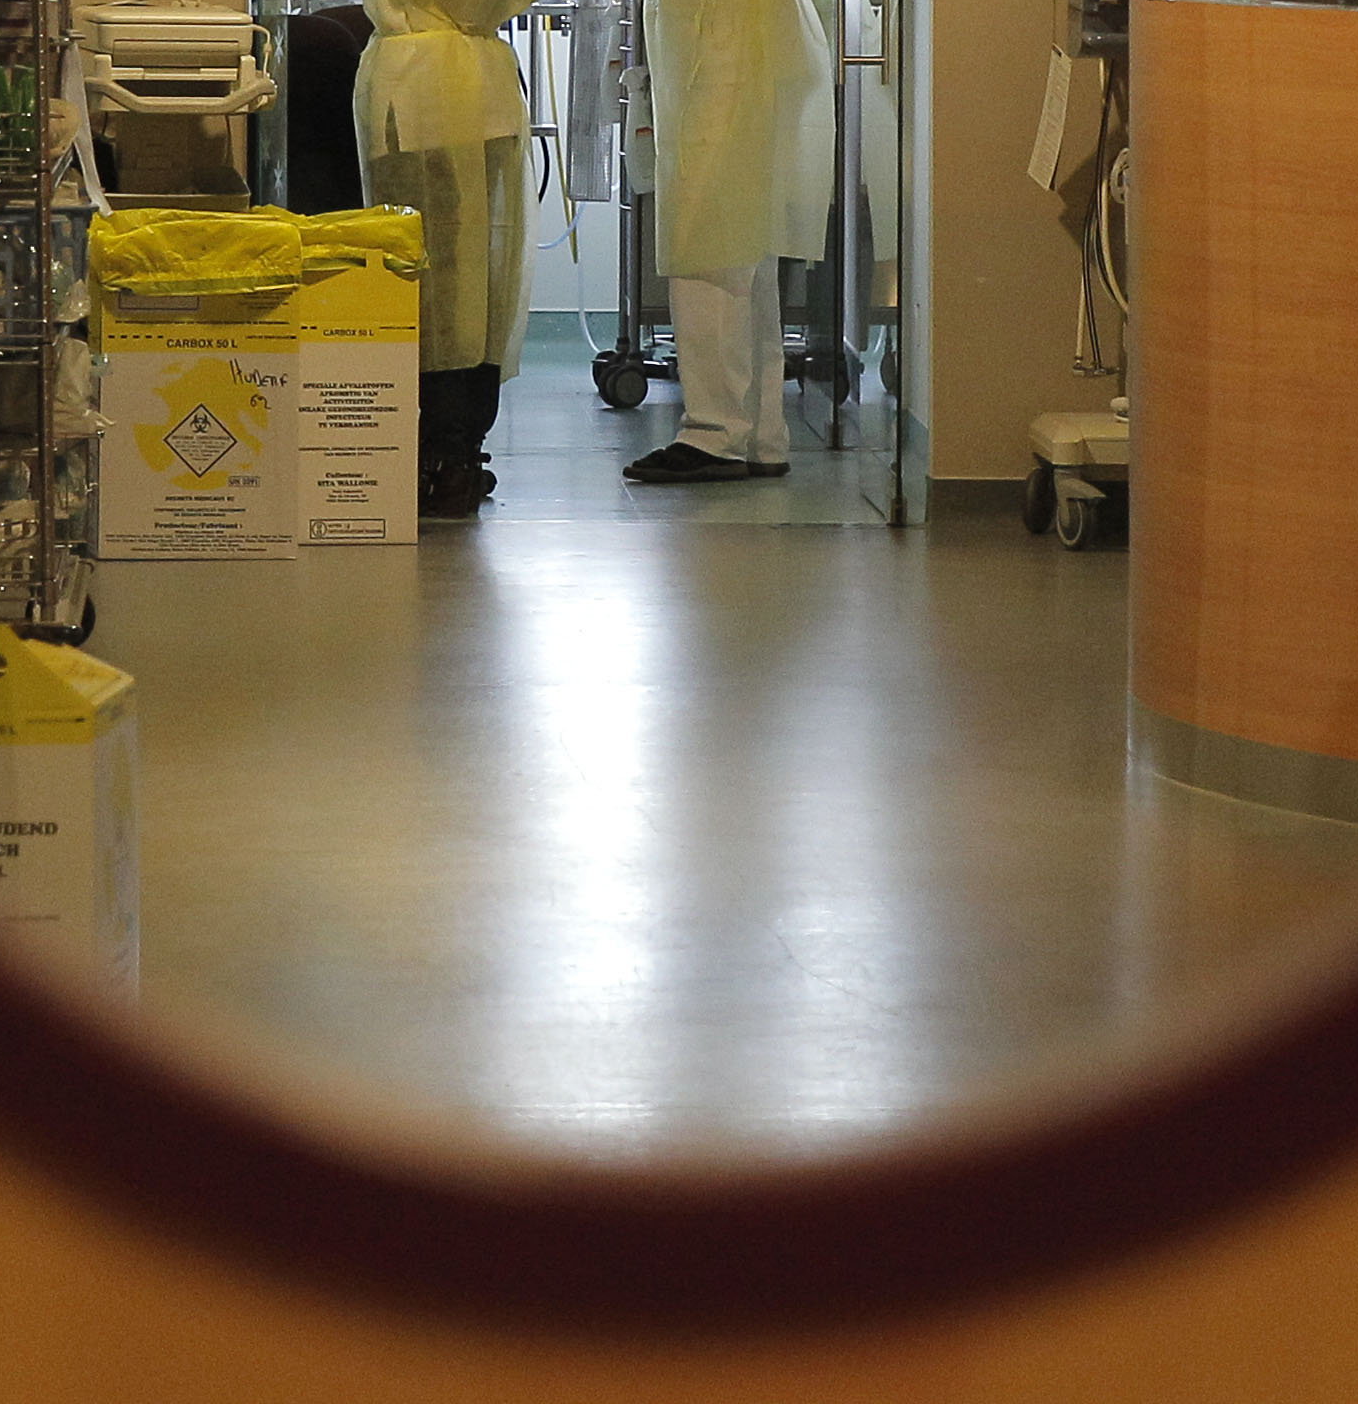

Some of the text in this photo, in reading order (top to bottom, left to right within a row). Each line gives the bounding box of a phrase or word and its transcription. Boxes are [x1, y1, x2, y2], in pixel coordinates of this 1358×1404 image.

[166, 338, 238, 348] CARBOX 50 L
